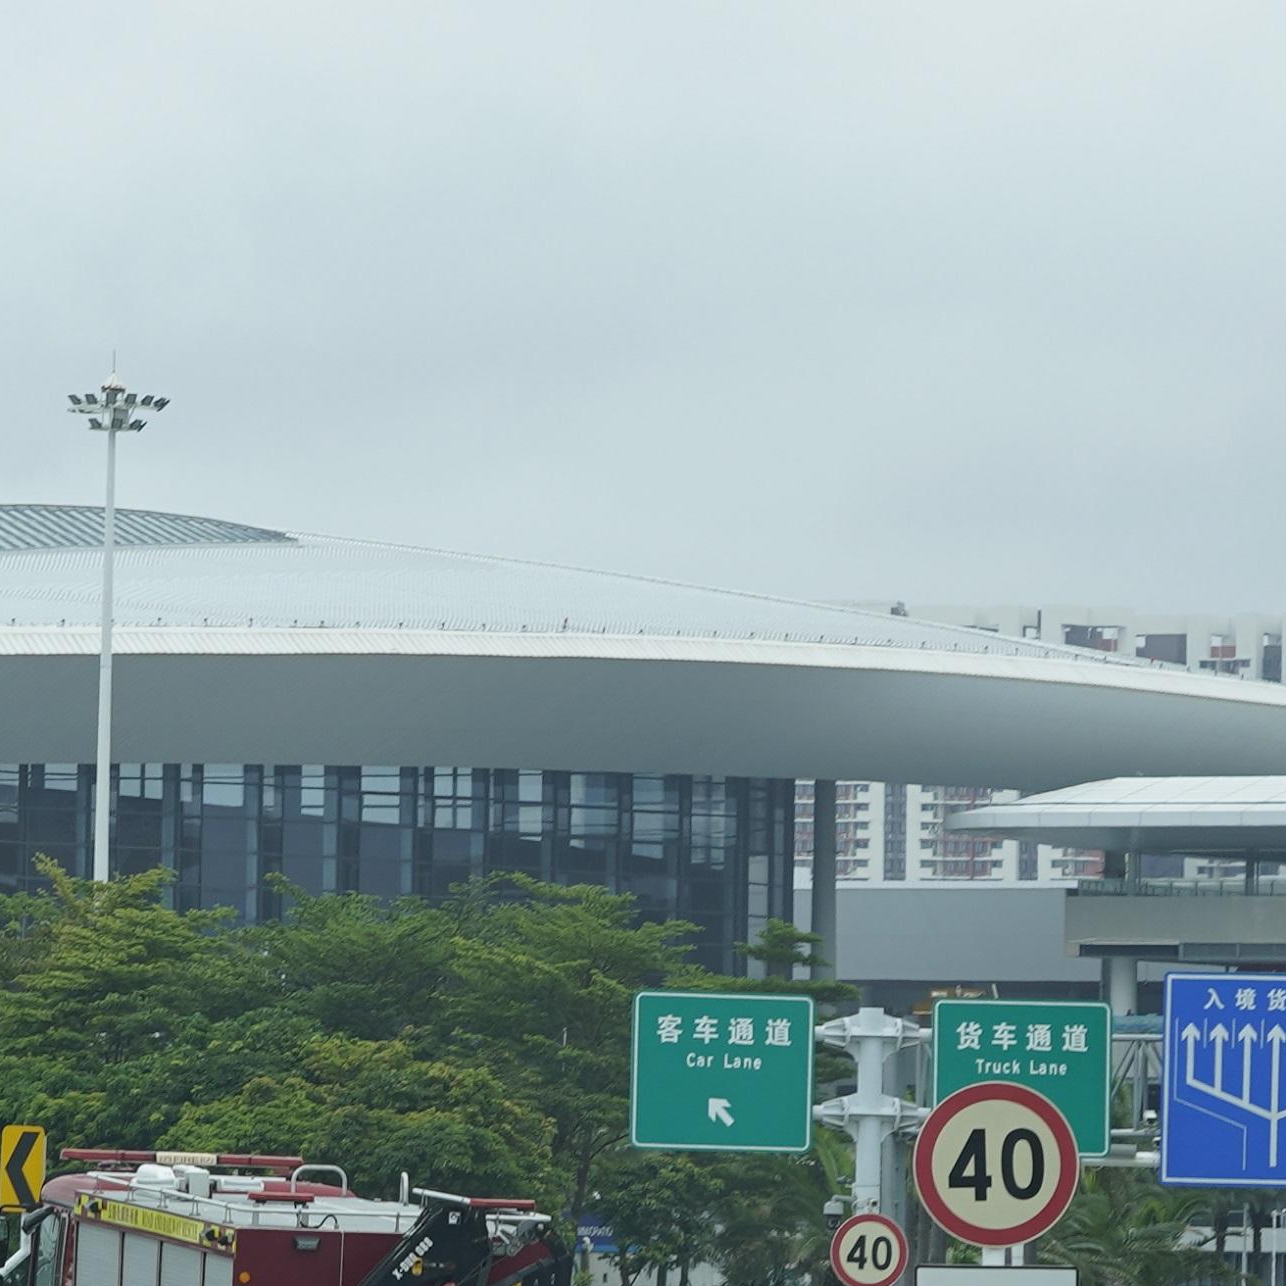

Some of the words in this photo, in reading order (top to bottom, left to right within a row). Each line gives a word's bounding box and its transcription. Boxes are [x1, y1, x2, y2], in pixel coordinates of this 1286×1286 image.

[656, 1014, 793, 1046] 客车通道
[956, 1020, 1089, 1053] 货车通道
[686, 1052, 714, 1069] Car
[723, 1053, 762, 1070] Lane
[975, 1058, 1021, 1075] Truck
[1029, 1059, 1069, 1076] Lane
[947, 1127, 1046, 1203] 40
[846, 1235, 893, 1270] 40
